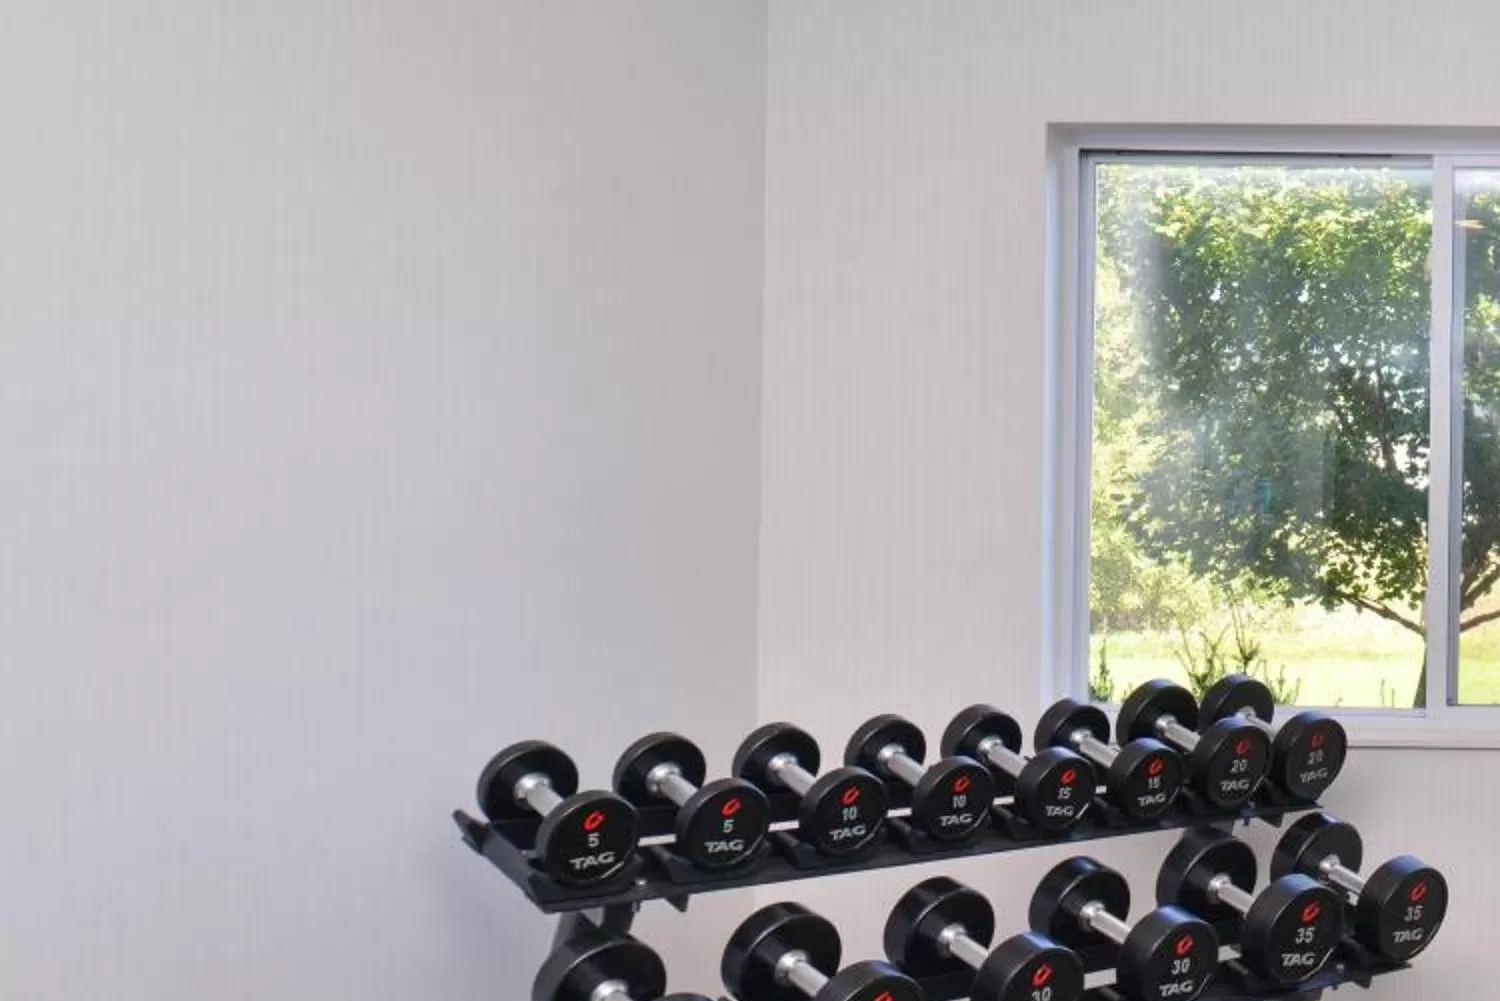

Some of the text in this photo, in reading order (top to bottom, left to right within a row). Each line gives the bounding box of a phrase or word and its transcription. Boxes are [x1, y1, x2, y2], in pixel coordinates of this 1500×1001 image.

[1230, 759, 1247, 772] 20
[1300, 767, 1328, 783] TAG
[1148, 776, 1161, 790] 15
[1220, 779, 1250, 792] TAG
[1058, 787, 1071, 799] 15
[1138, 793, 1166, 807] TAG
[953, 795, 966, 808] 10
[842, 807, 857, 821] 10
[1046, 804, 1074, 817] TAG
[723, 818, 735, 833] 5
[940, 813, 973, 827] TAG
[587, 832, 600, 847] 5
[830, 824, 866, 841] TAG
[704, 838, 744, 852] TAG
[569, 851, 616, 870] TAG
[1404, 905, 1424, 922] 35
[1295, 927, 1315, 944] 35
[1392, 928, 1424, 943] TAG
[1281, 951, 1316, 966] TAG
[1171, 958, 1190, 975] 30
[1159, 979, 1193, 997] TAG
